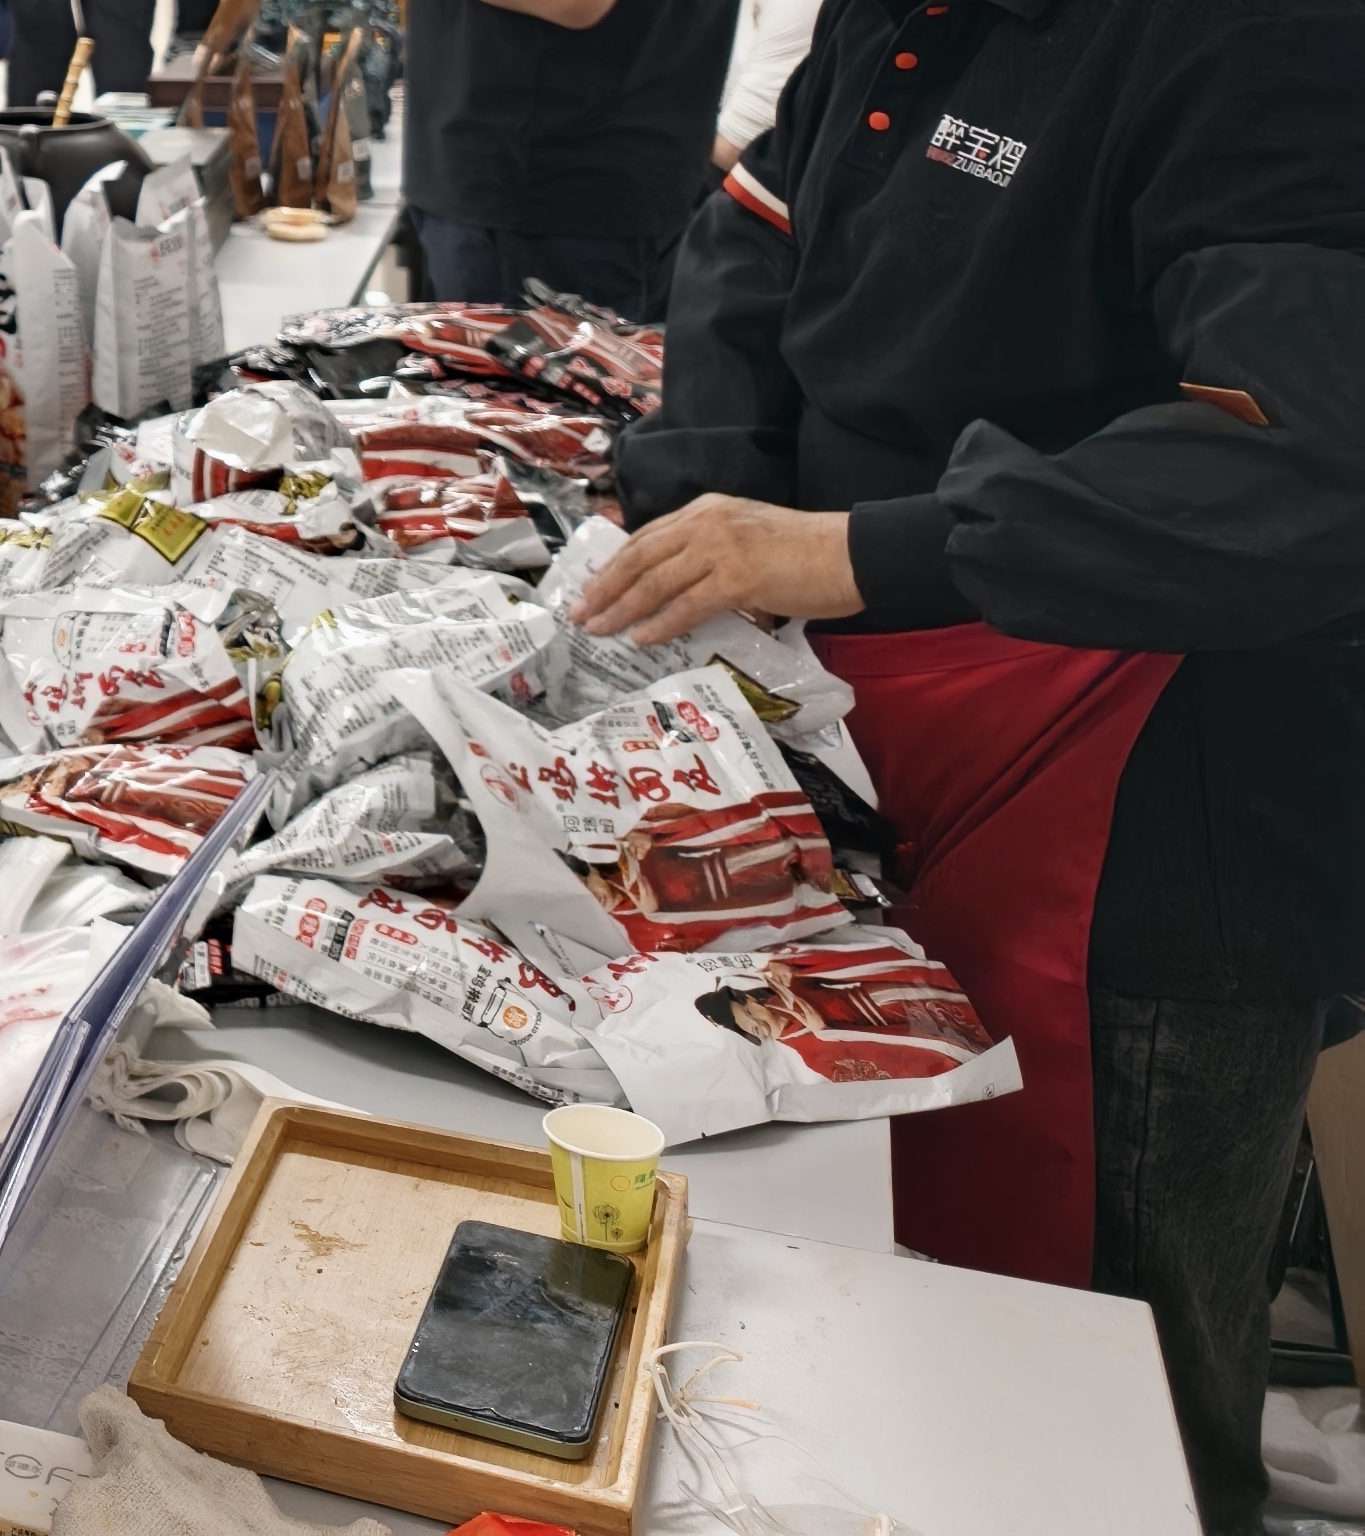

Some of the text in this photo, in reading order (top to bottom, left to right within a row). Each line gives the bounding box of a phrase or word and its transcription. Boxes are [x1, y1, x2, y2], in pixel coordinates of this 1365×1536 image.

[930, 114, 1027, 175] 醉宝鸡
[953, 156, 1012, 187] ZUIBAOJI
